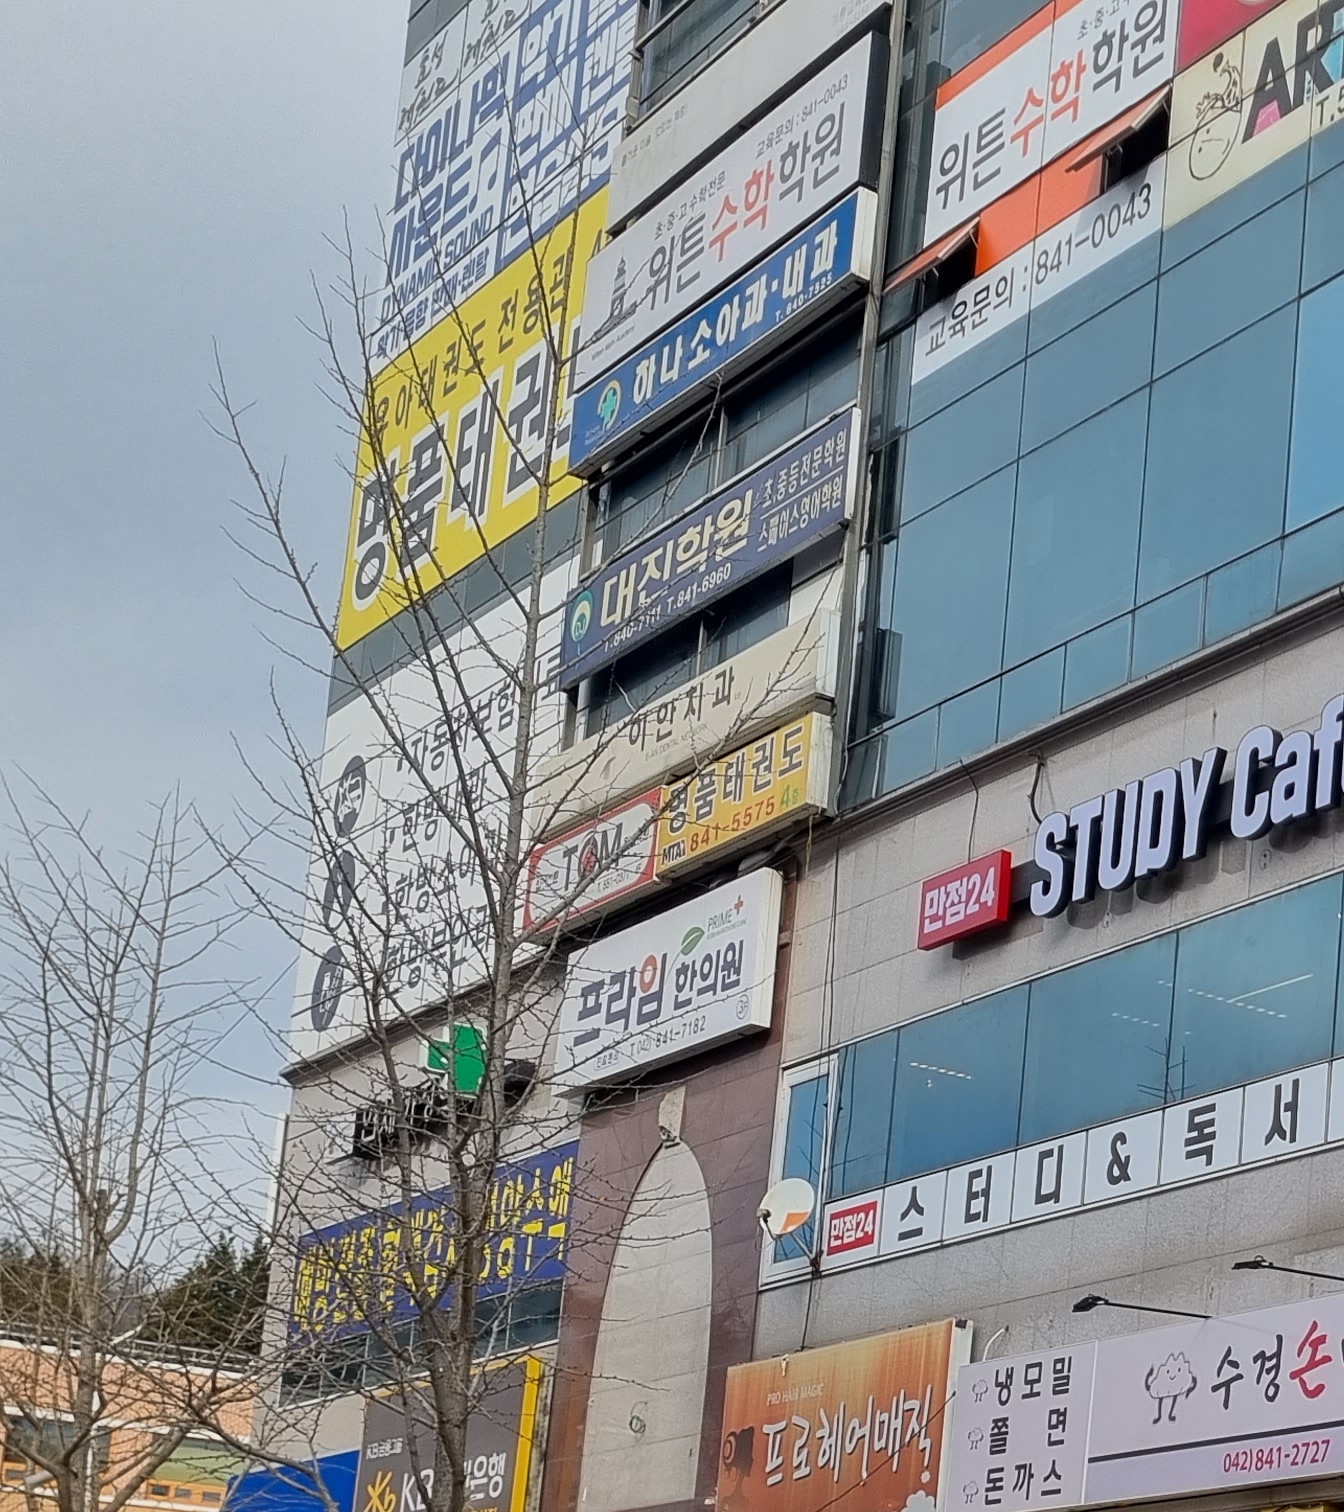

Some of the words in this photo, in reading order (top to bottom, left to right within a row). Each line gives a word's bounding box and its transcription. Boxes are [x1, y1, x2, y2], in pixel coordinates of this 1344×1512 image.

[755, 120, 794, 160] 교육문의
[800, 74, 849, 123] 841-0043
[443, 205, 494, 270] SOUND
[923, 267, 1015, 358] 교육문의
[1033, 182, 1153, 288] 841-0043
[601, 489, 753, 628] 대진학원
[666, 562, 732, 614] T.841-6960
[628, 666, 735, 751] 이안치과
[668, 724, 804, 836] 명품태권도
[689, 795, 775, 853] 841-5575
[923, 865, 996, 936] 만점24
[1029, 746, 1227, 919] STUDY
[706, 912, 733, 933] PRIME
[573, 952, 668, 1048] 프라임
[673, 939, 745, 1012] 한의원
[655, 1015, 707, 1048] 841-7182
[829, 1208, 876, 1246] 만점24
[766, 1391, 781, 1407] PRO
[994, 1355, 1073, 1407] 냉모밀
[762, 1383, 933, 1488] 프로헤어매직
[988, 1407, 1068, 1456] 쫄면
[984, 1458, 1064, 1506] 돈까스
